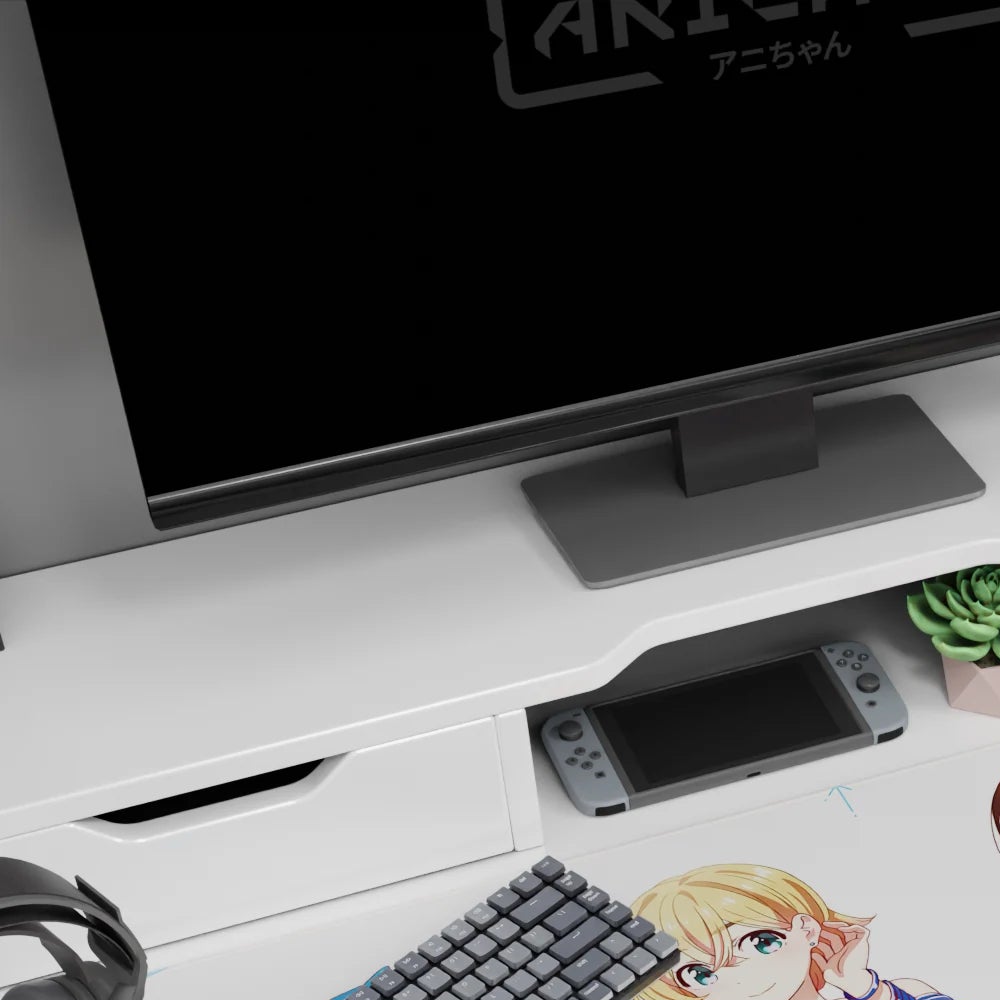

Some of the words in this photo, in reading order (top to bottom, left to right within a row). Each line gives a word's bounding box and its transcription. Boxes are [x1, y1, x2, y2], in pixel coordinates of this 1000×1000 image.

[709, 31, 852, 80] アニちゃん
